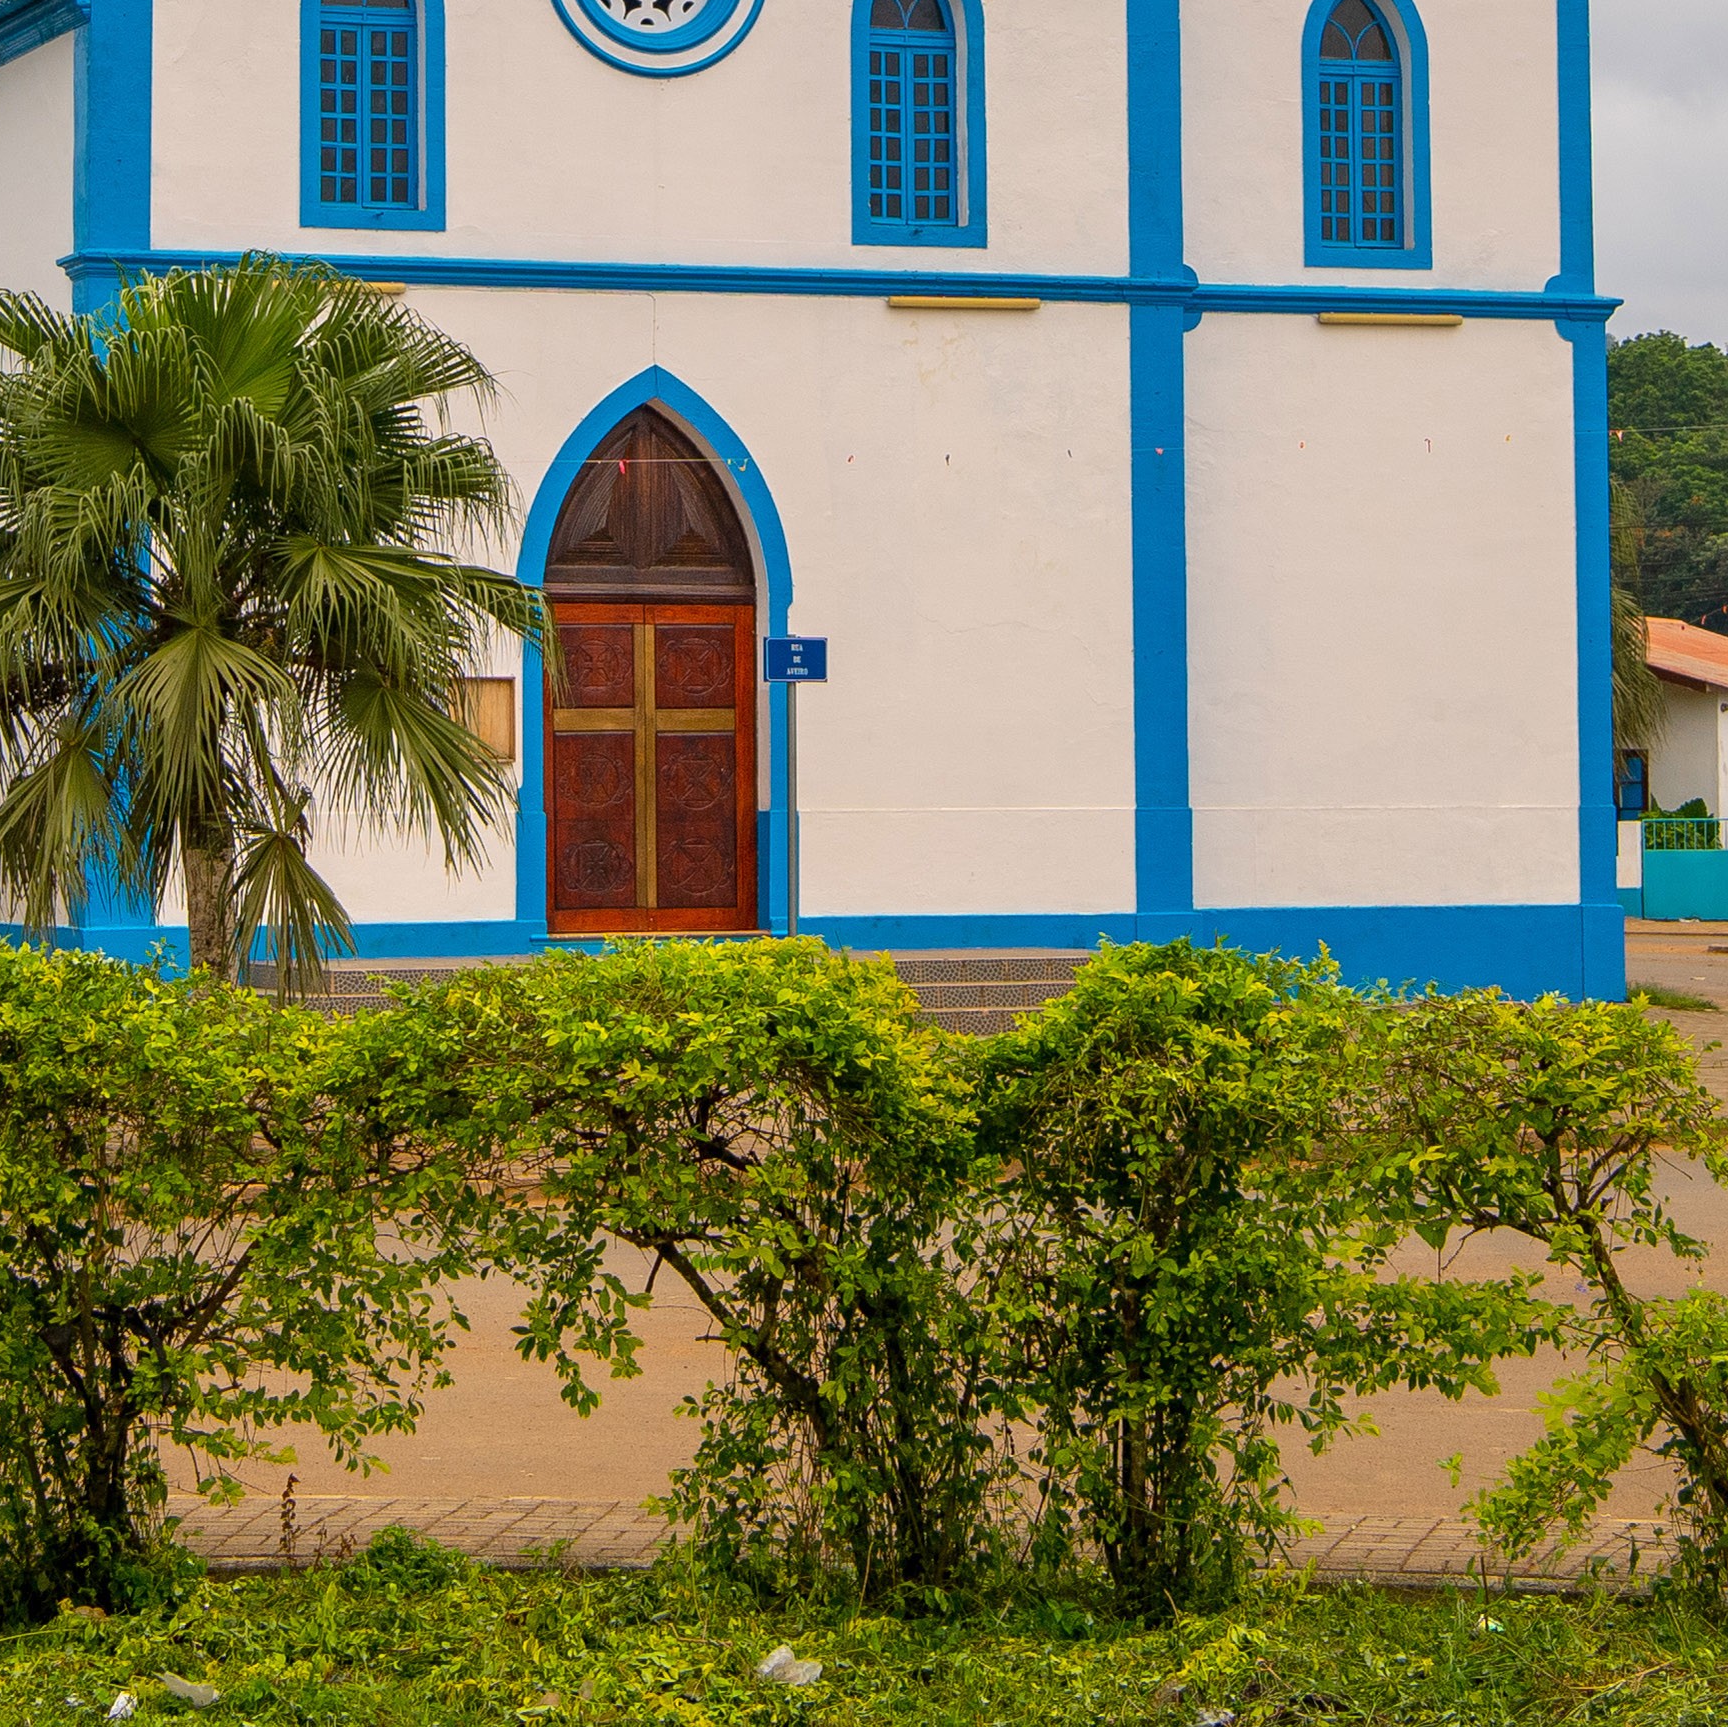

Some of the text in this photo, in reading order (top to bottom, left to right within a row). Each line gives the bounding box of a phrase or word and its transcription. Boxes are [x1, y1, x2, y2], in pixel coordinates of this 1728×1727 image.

[791, 643, 803, 652] RUA
[793, 655, 802, 663] DE
[786, 667, 809, 675] AVEIRO
